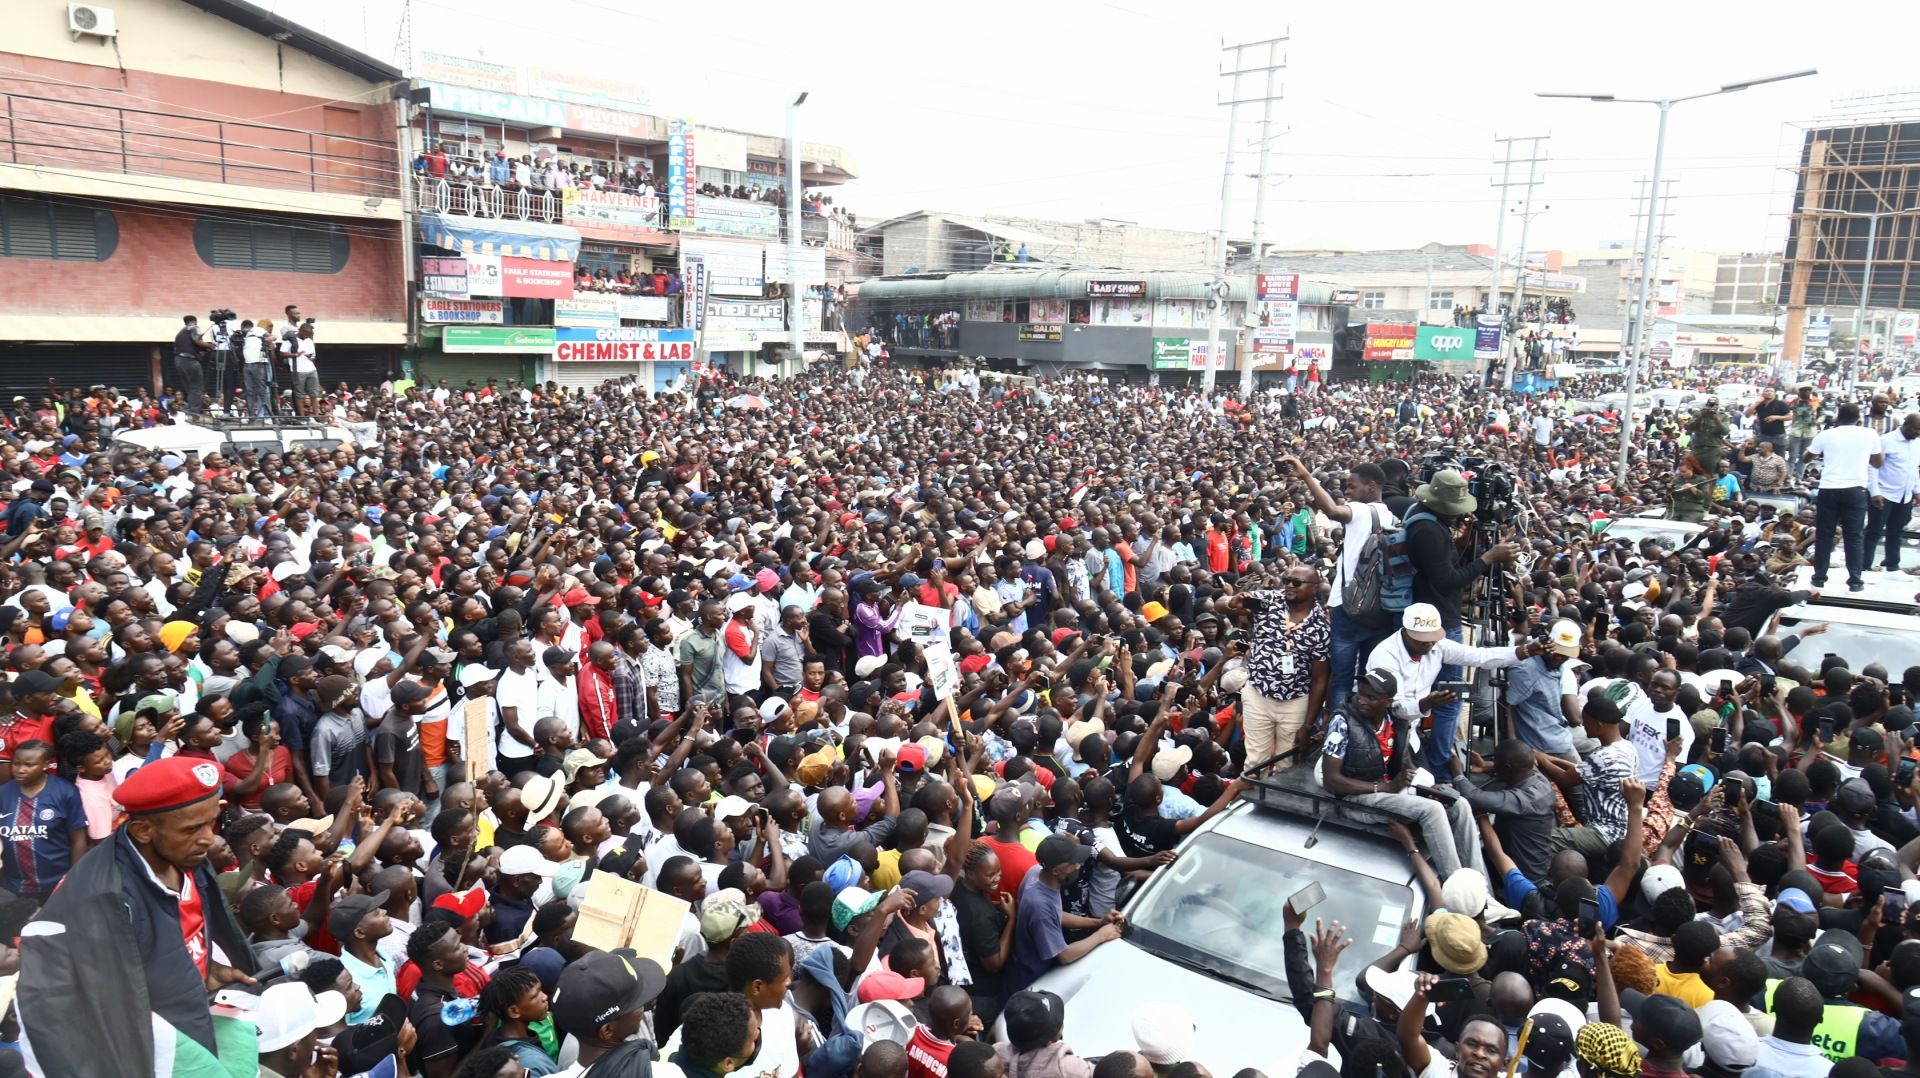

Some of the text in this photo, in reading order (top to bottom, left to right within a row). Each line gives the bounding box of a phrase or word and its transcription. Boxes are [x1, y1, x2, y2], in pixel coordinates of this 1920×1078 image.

[430, 87, 566, 126] AFRICANA
[571, 108, 640, 128] DRIVING
[583, 123, 633, 136] SCHOOL
[670, 136, 686, 218] AFRICANA
[687, 137, 695, 218] DRIVING SCHOOL
[580, 190, 657, 209] HARVEYNET
[503, 267, 529, 275] EAGLE
[1094, 284, 1140, 293] BABY SHOP
[427, 301, 502, 313] EAGLE STATIONERS
[750, 304, 782, 318] CAFE
[430, 311, 481, 322] & BOOKSHOP
[596, 329, 659, 341] GONDIAN
[1034, 325, 1061, 333] SALON
[514, 336, 554, 344] Safaricom
[1431, 335, 1464, 352] oppo
[557, 342, 692, 361] CHEMIST & LAB
[0, 825, 48, 839] QATAR
[1811, 1033, 1847, 1054] eta
